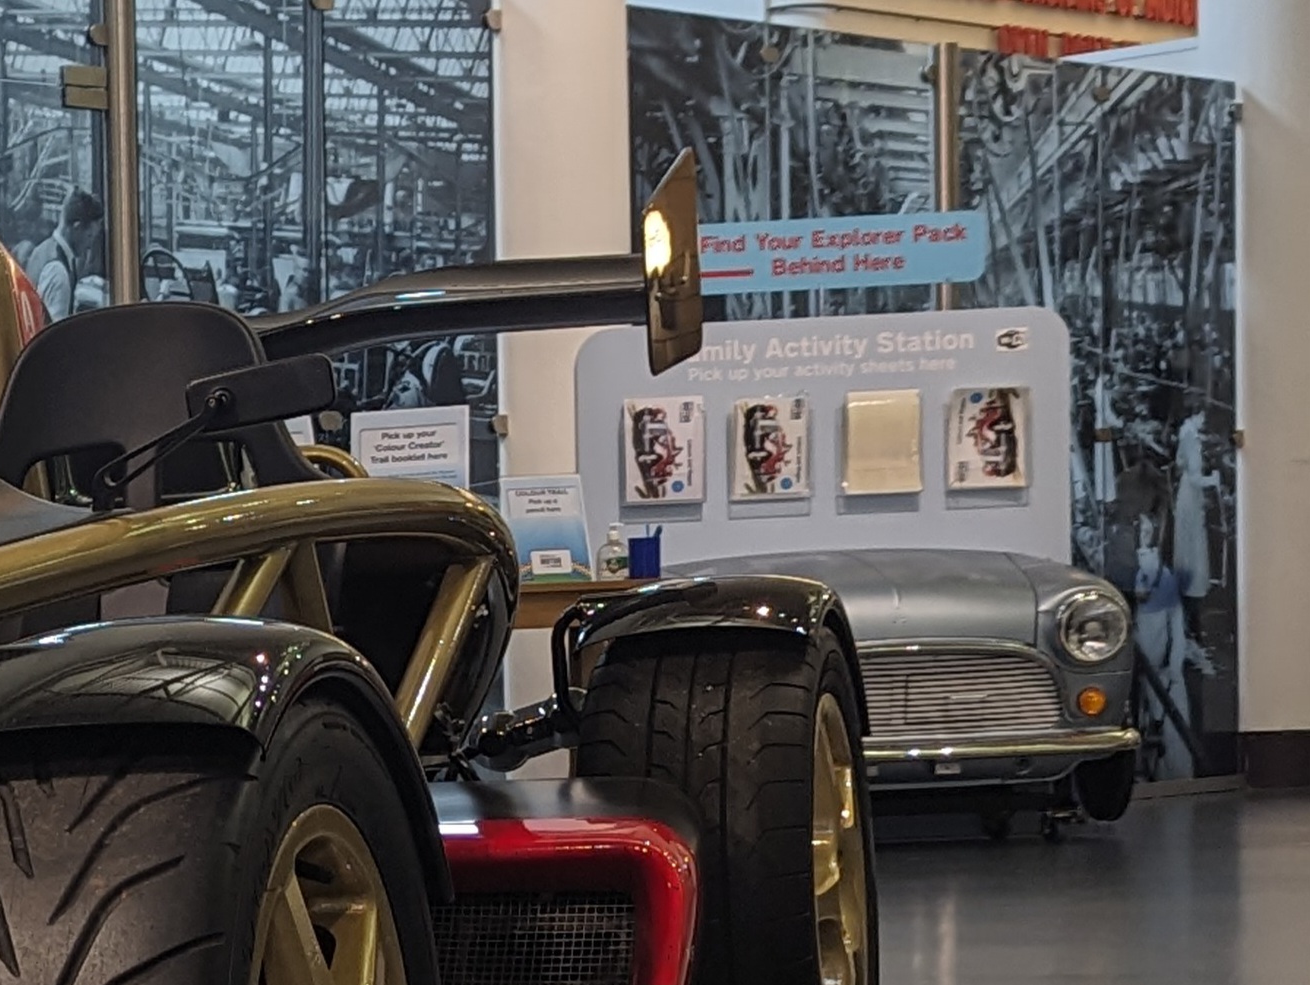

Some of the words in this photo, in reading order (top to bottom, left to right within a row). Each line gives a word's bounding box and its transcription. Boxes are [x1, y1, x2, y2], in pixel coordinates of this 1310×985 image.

[700, 234, 746, 254] Find
[756, 231, 804, 251] Your
[811, 227, 906, 250] Explorer
[912, 222, 967, 242] Pack
[772, 254, 846, 276] Behind
[853, 253, 907, 271] Here
[688, 338, 757, 365] mily
[765, 332, 867, 360] Activity
[876, 329, 975, 352] Station
[687, 367, 724, 382] Pick
[729, 368, 749, 382] up
[753, 365, 790, 382] your
[795, 359, 855, 378] activity
[861, 359, 914, 375] sheets
[919, 356, 958, 371] here
[381, 431, 400, 440] Pick
[403, 432, 414, 440] up
[416, 430, 437, 439] your
[370, 456, 389, 464] Trail
[391, 453, 426, 463] booklet
[427, 452, 448, 460] here
